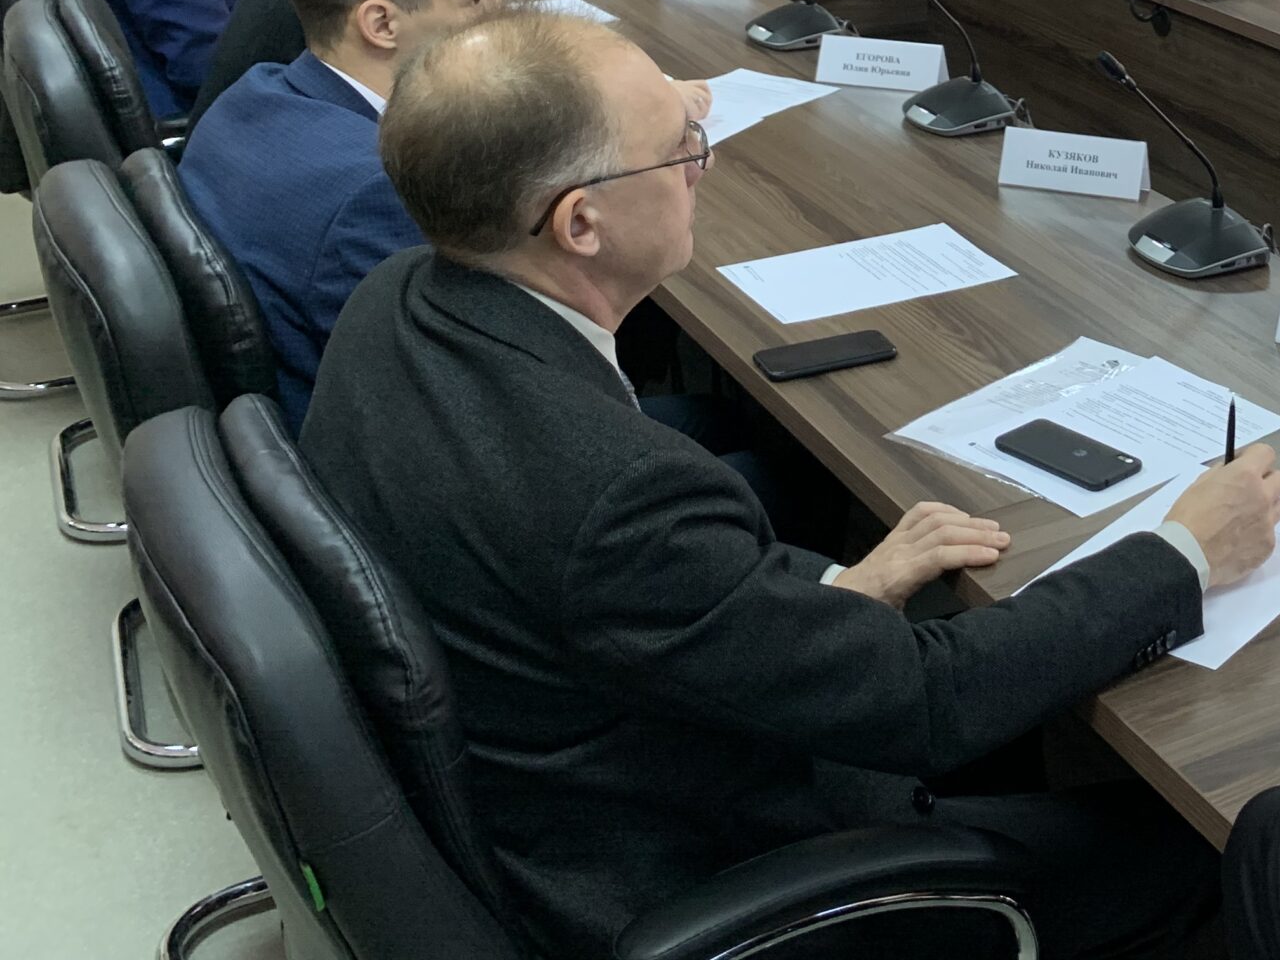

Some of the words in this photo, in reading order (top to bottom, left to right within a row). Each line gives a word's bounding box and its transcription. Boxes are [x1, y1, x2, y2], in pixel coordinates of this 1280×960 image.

[856, 53, 901, 65] ЕГОРОВА
[842, 63, 868, 73] Юлия
[871, 65, 910, 76] Юрьевна
[1048, 149, 1099, 164] КУЗЯКОВ
[1026, 160, 1068, 173] Николай
[1071, 165, 1118, 179] Иванович
